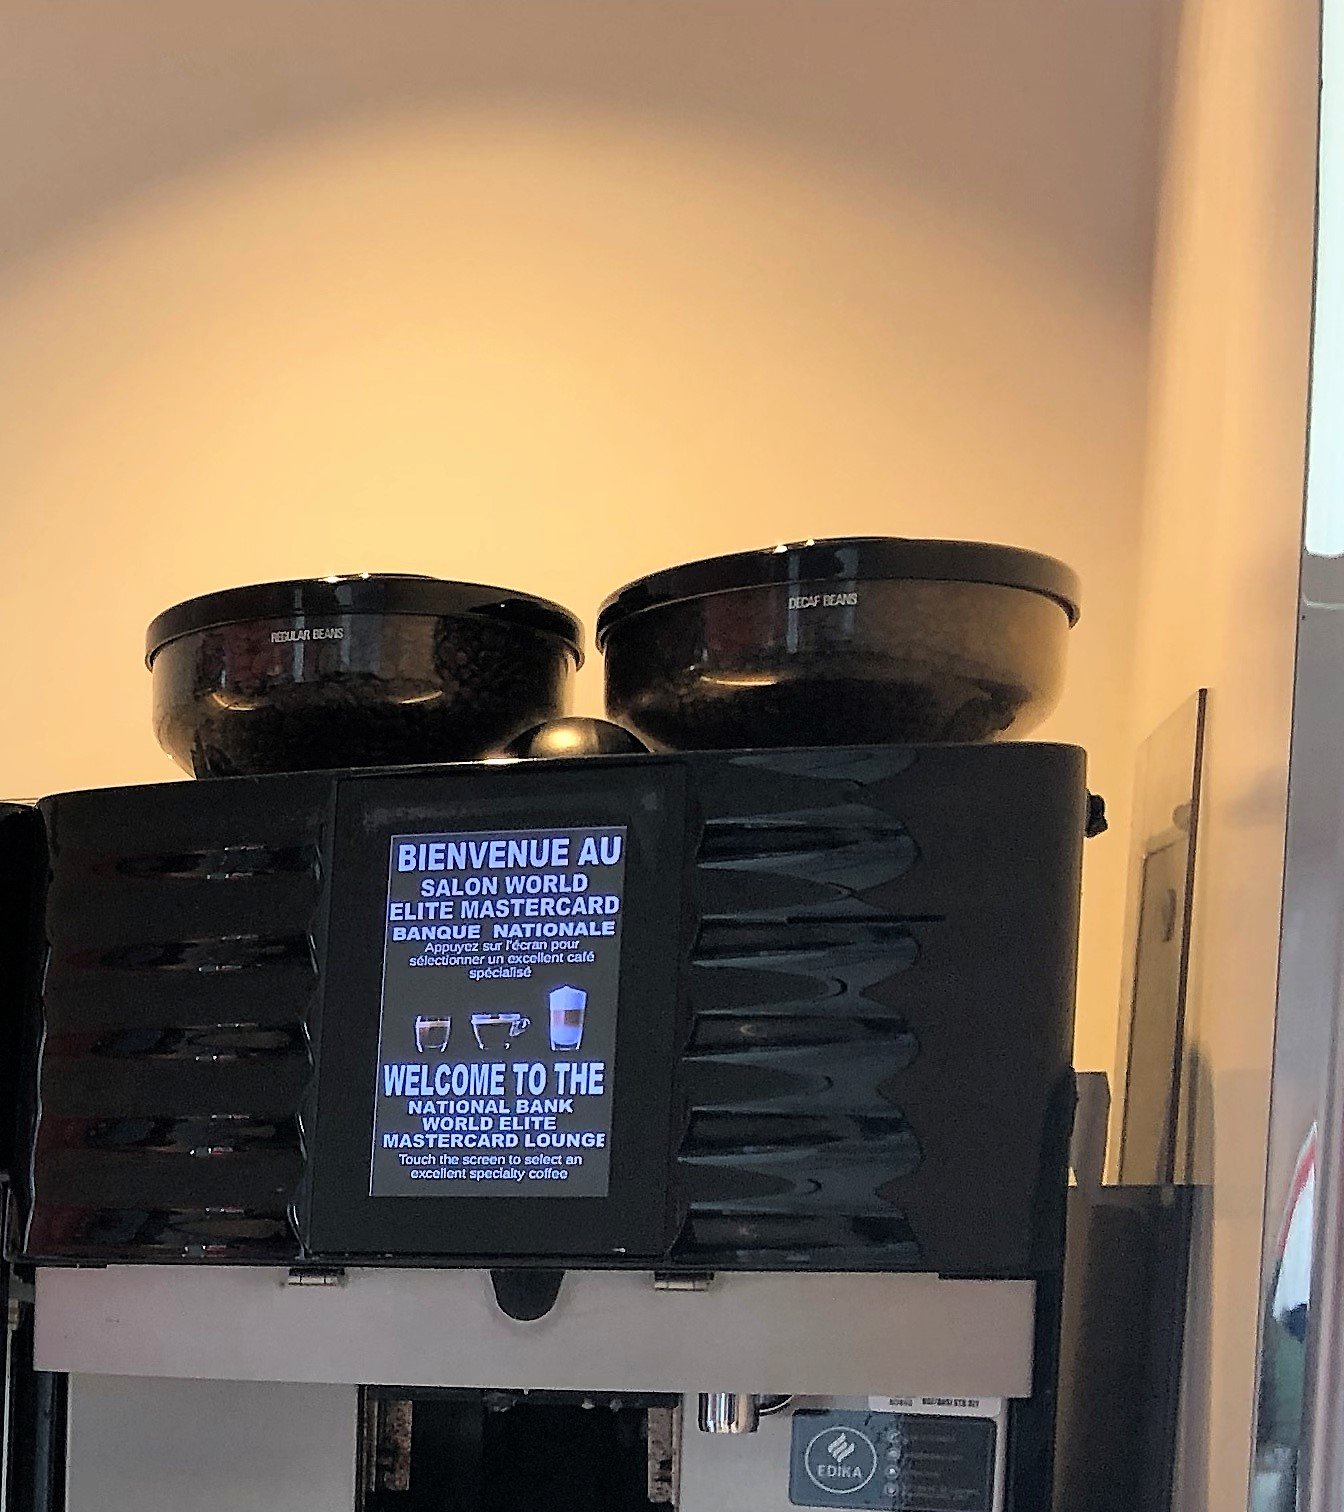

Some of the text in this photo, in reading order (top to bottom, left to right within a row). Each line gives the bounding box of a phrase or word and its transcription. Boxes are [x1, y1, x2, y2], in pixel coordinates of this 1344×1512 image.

[788, 593, 858, 610] DECAF BEANS
[271, 628, 344, 643] REGULAR BEANS
[398, 836, 622, 873] BIENVENUE AU
[420, 873, 588, 897] SALON WORLD
[389, 895, 620, 921] ELITE MASTERCARD
[392, 921, 616, 941] BANQUE NATIONALE
[424, 942, 479, 955] Appuyez
[483, 943, 502, 952] sur
[551, 941, 580, 953] pour
[409, 951, 595, 967] sélectionner un excellent café
[469, 966, 532, 981] spécialisé
[384, 1062, 605, 1096] WELCOME TO THE
[408, 1099, 574, 1115] NATIONAL BANK
[422, 1117, 557, 1131] WORLD ELITE
[383, 1133, 605, 1148] MASTERCARD LOUNGE
[398, 1154, 583, 1166] Touch the screen to select an
[410, 1168, 568, 1182] excellent specialty coffee
[817, 1464, 863, 1479] EDIKA
